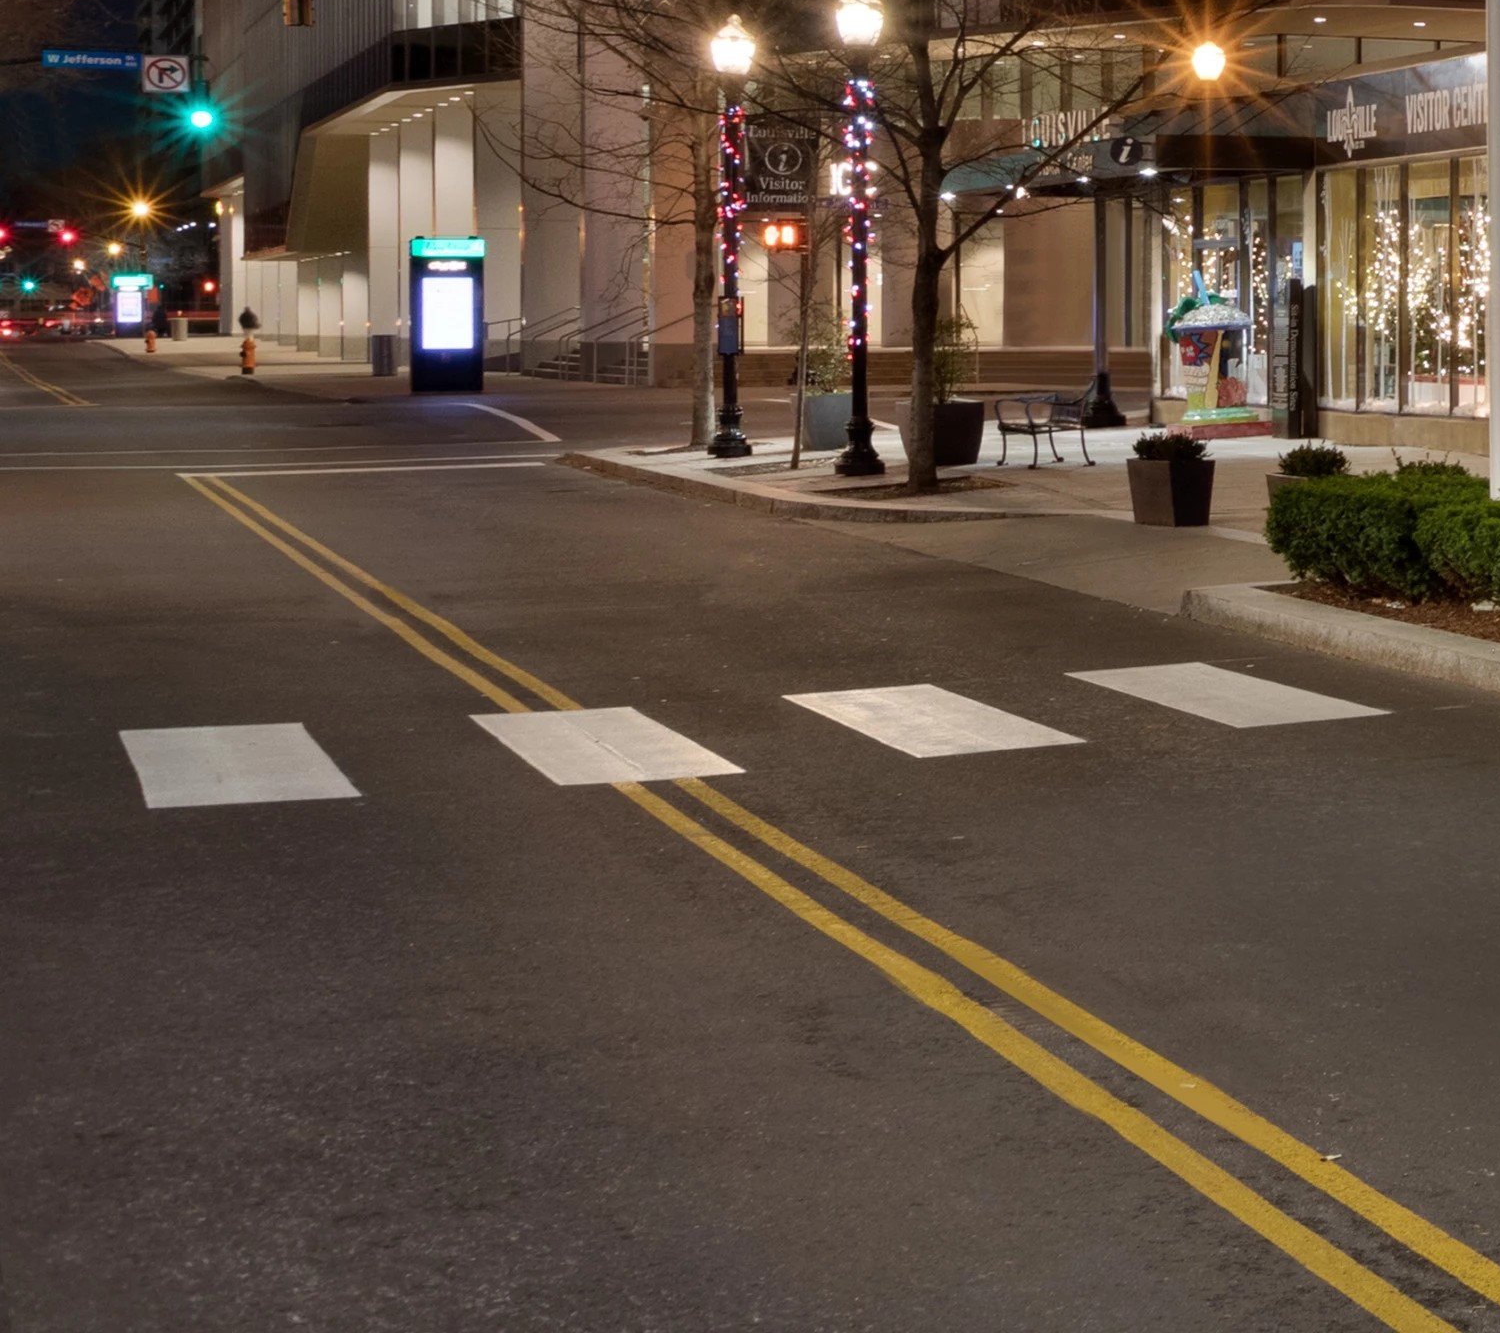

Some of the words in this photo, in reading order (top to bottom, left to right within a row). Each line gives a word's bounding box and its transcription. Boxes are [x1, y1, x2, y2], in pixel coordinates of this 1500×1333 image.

[47, 54, 60, 64] W
[63, 55, 122, 65] Jefferson
[1405, 88, 1450, 134] VISITOR
[1452, 83, 1488, 129] CENT
[1326, 103, 1377, 143] LOUIVILLE
[748, 125, 817, 139] Louisville
[759, 176, 806, 190] Visitor
